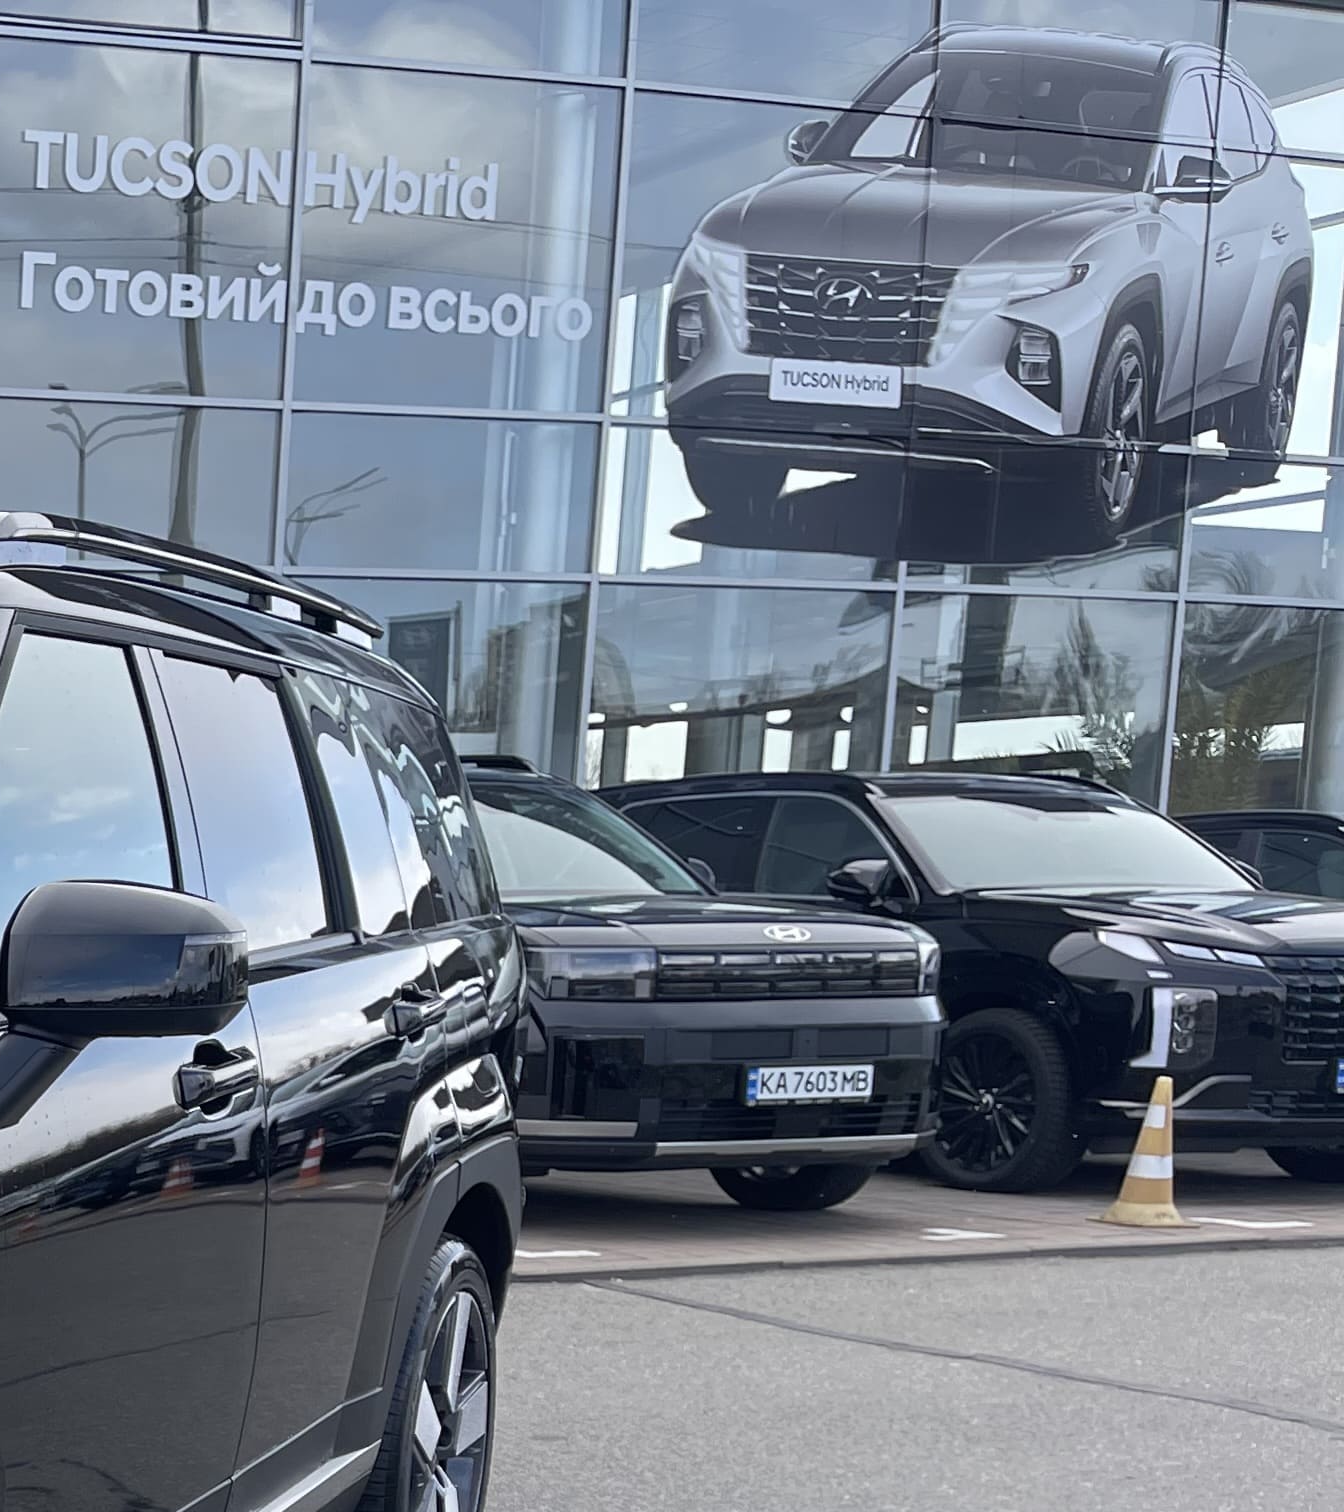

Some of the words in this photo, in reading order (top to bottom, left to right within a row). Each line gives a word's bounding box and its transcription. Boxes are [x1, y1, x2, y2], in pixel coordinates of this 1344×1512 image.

[23, 128, 291, 206] TUCSON
[302, 151, 498, 224] Hybrid
[20, 249, 287, 324] Готовий
[294, 278, 376, 336] до
[388, 285, 593, 340] всього
[782, 370, 841, 389] TUCSON
[845, 374, 889, 394] Hybrid
[760, 1072, 788, 1094] KA
[793, 1071, 838, 1093] 7603
[841, 1070, 869, 1092] MB
